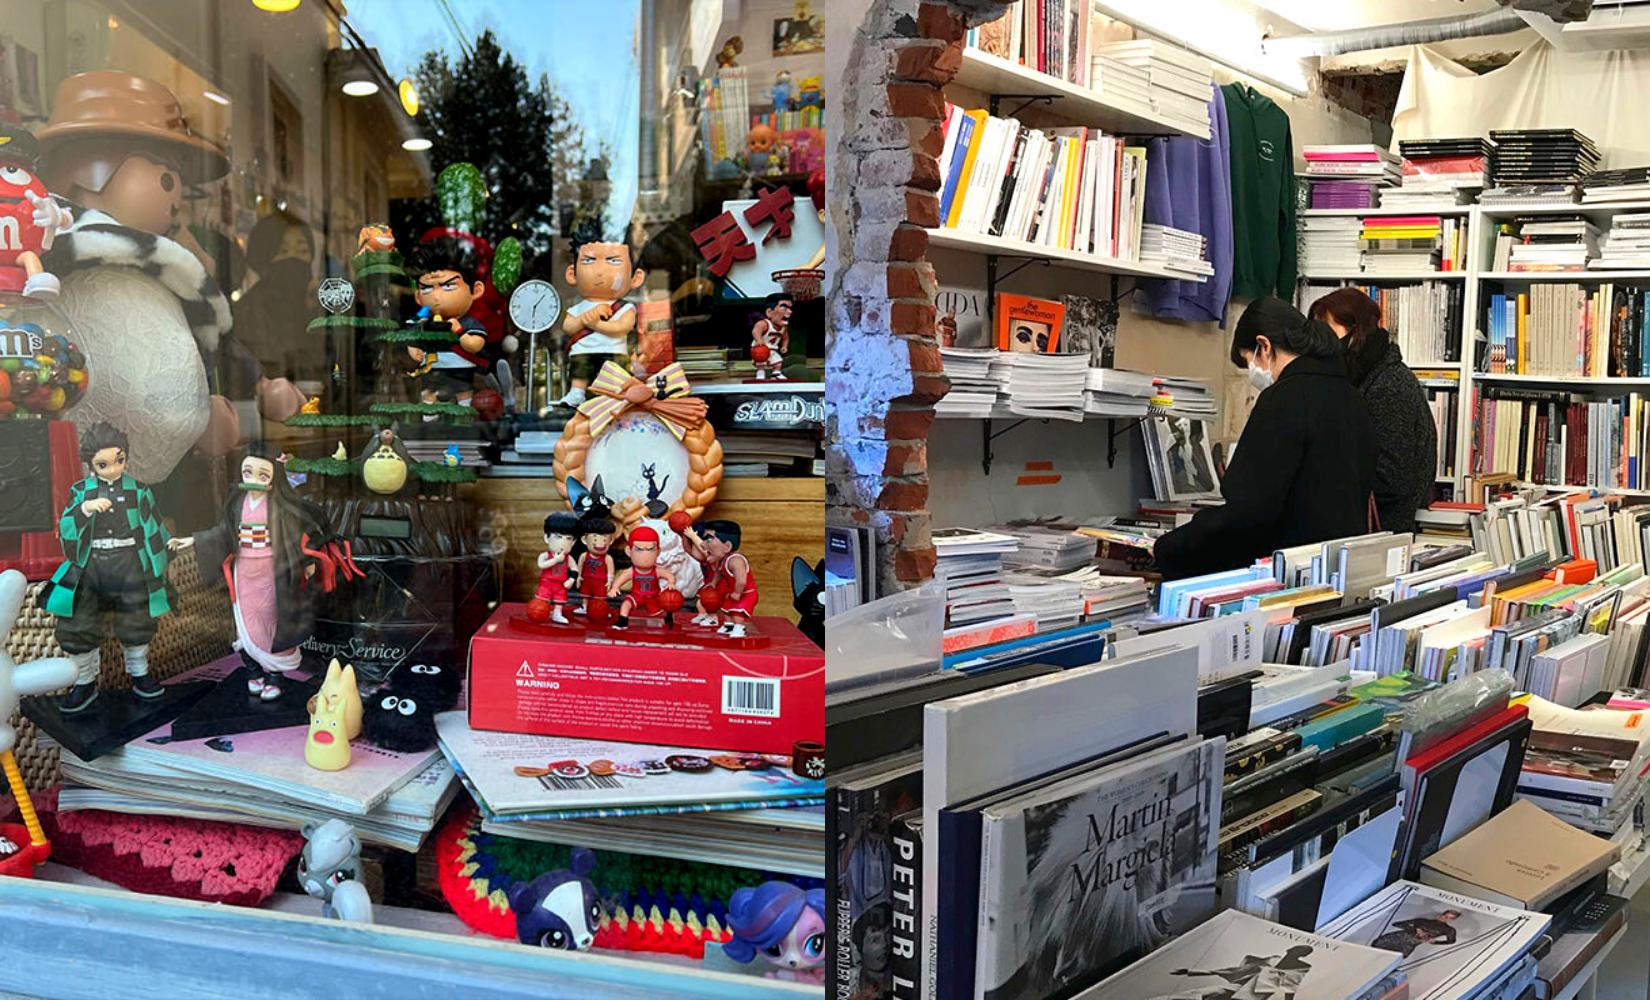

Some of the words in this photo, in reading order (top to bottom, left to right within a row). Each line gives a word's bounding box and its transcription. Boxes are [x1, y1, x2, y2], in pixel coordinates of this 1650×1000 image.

[690, 185, 795, 278] 天才
[1009, 306, 1056, 321] gentlewoman
[1026, 301, 1039, 310] the
[302, 635, 344, 659] elivery
[341, 638, 406, 660] Service
[515, 679, 560, 690] WARNING
[1083, 793, 1172, 853] Martin
[1068, 821, 1176, 903] Margiela
[893, 836, 914, 959] PETER
[1437, 891, 1502, 913] MONUMENT
[1266, 927, 1343, 952] MONUMENT
[837, 944, 850, 980] ROLLER
